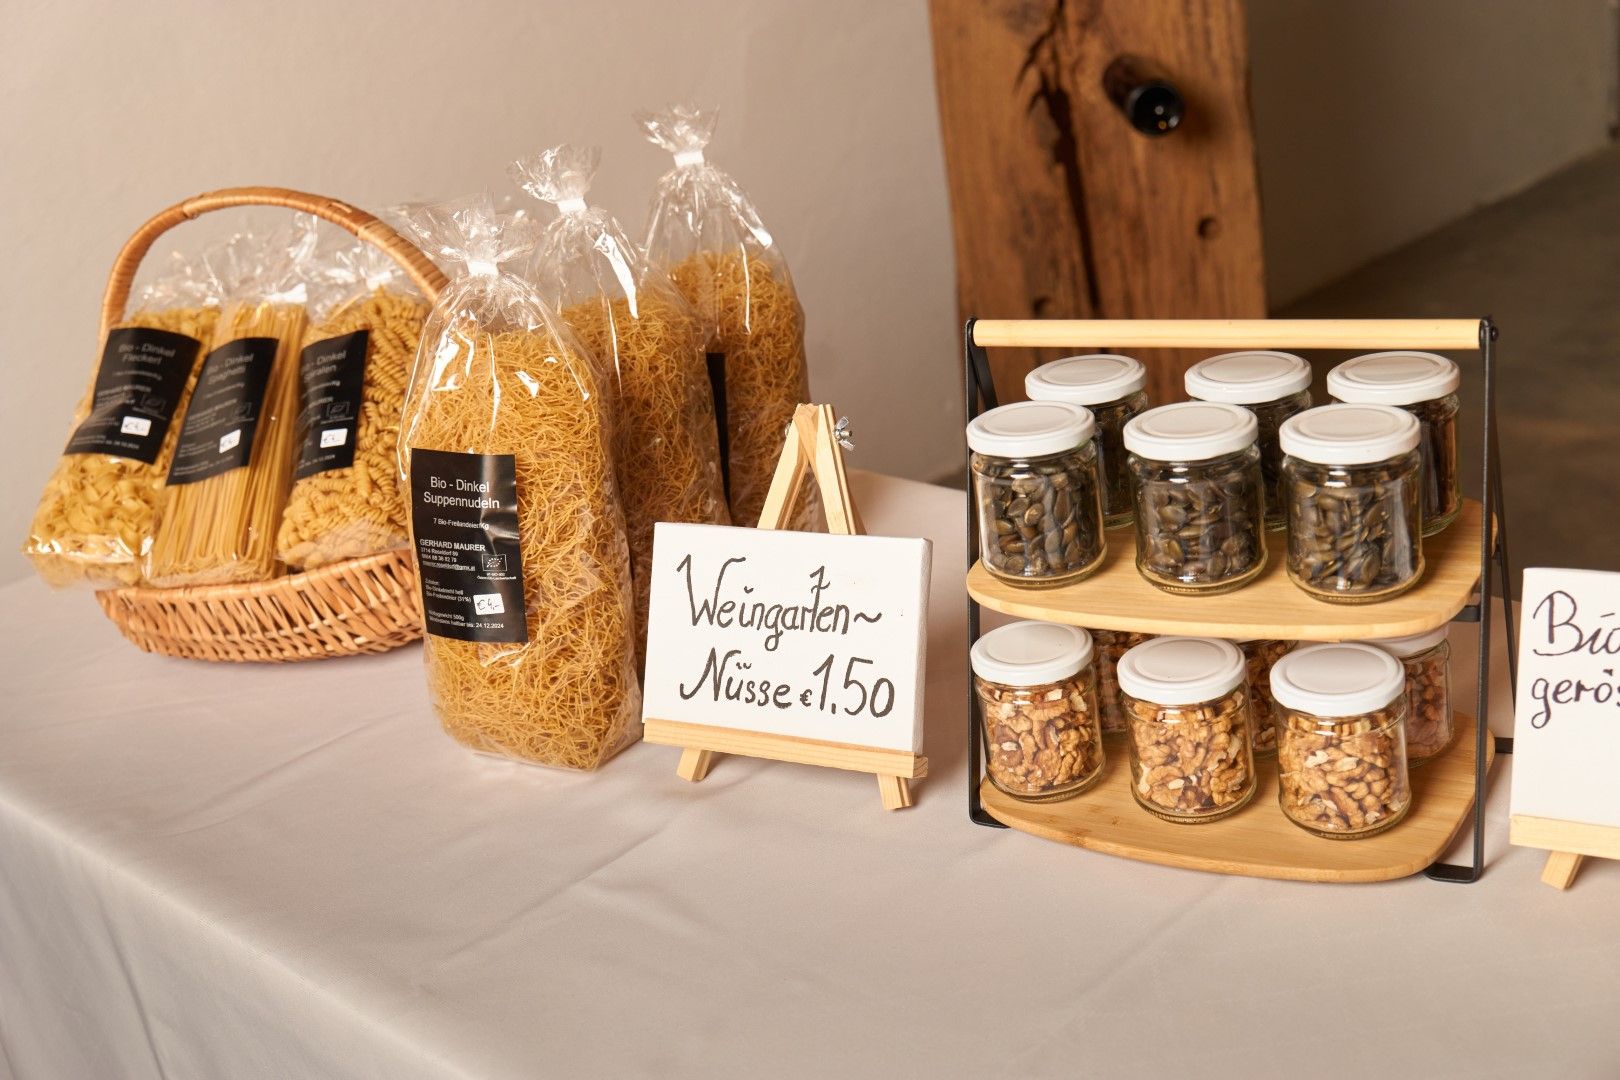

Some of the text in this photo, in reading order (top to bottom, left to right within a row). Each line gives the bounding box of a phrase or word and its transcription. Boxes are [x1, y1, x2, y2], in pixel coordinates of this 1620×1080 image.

[430, 476, 447, 489] Bio
[456, 479, 490, 493] Dinkel
[423, 491, 500, 509] Suppennudeln
[420, 538, 486, 552] GERHARD MAURER
[679, 647, 793, 709] Nüsse
